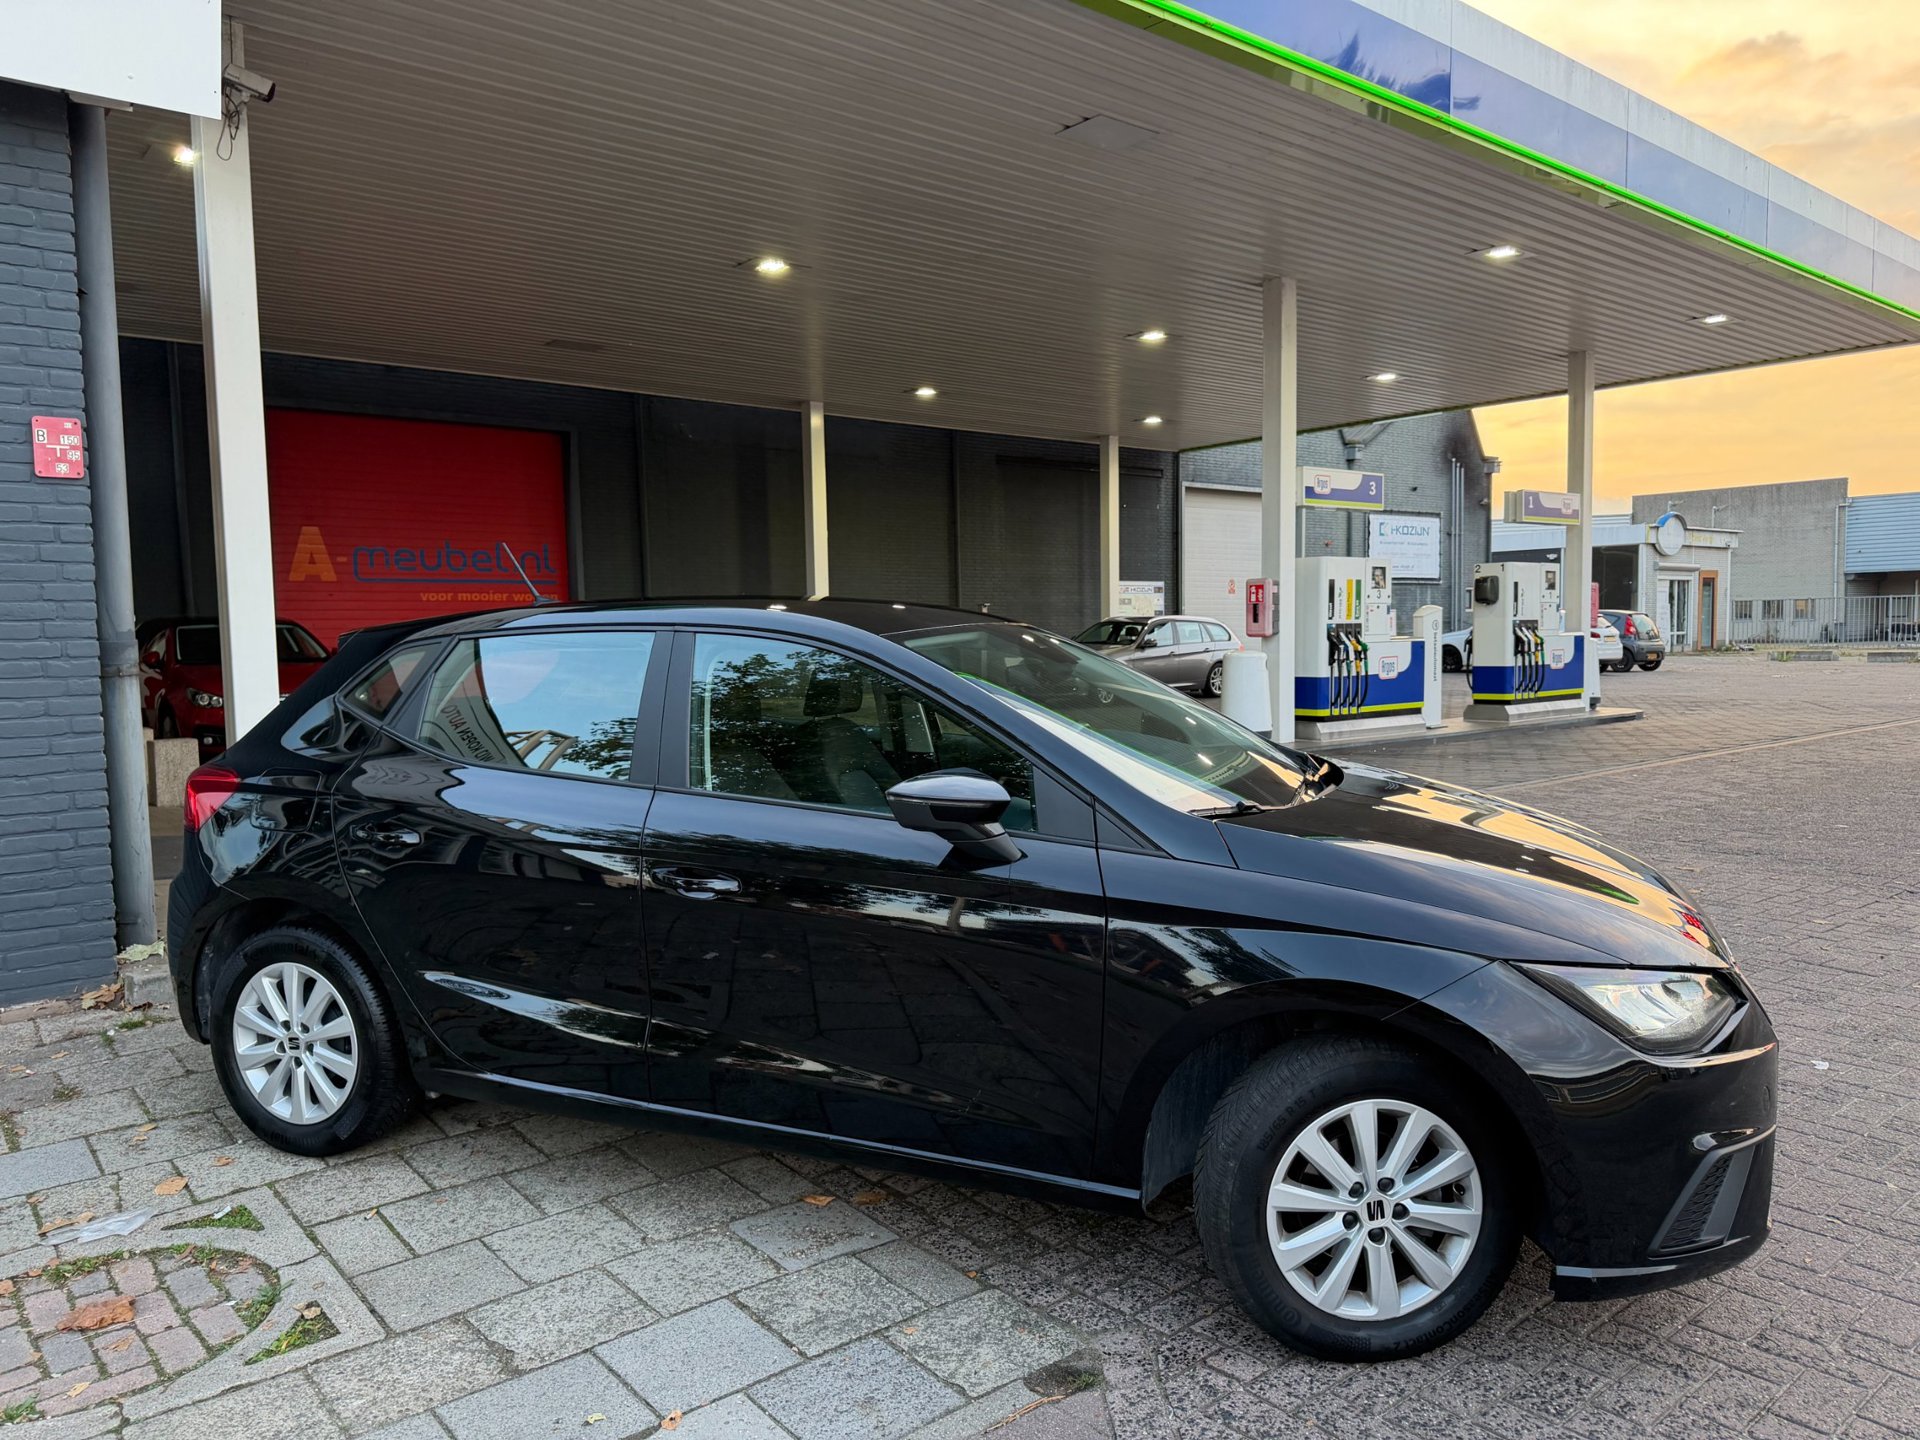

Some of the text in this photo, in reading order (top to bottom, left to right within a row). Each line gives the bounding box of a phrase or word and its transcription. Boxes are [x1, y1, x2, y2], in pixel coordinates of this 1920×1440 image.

[36, 429, 46, 442] B
[61, 435, 79, 445] 150
[1369, 481, 1377, 496] 3
[1528, 495, 1534, 509] 1
[1475, 564, 1481, 574] 2
[1501, 563, 1505, 572] 1
[420, 590, 559, 602] voor mooier woen
[1376, 589, 1382, 599] 3
